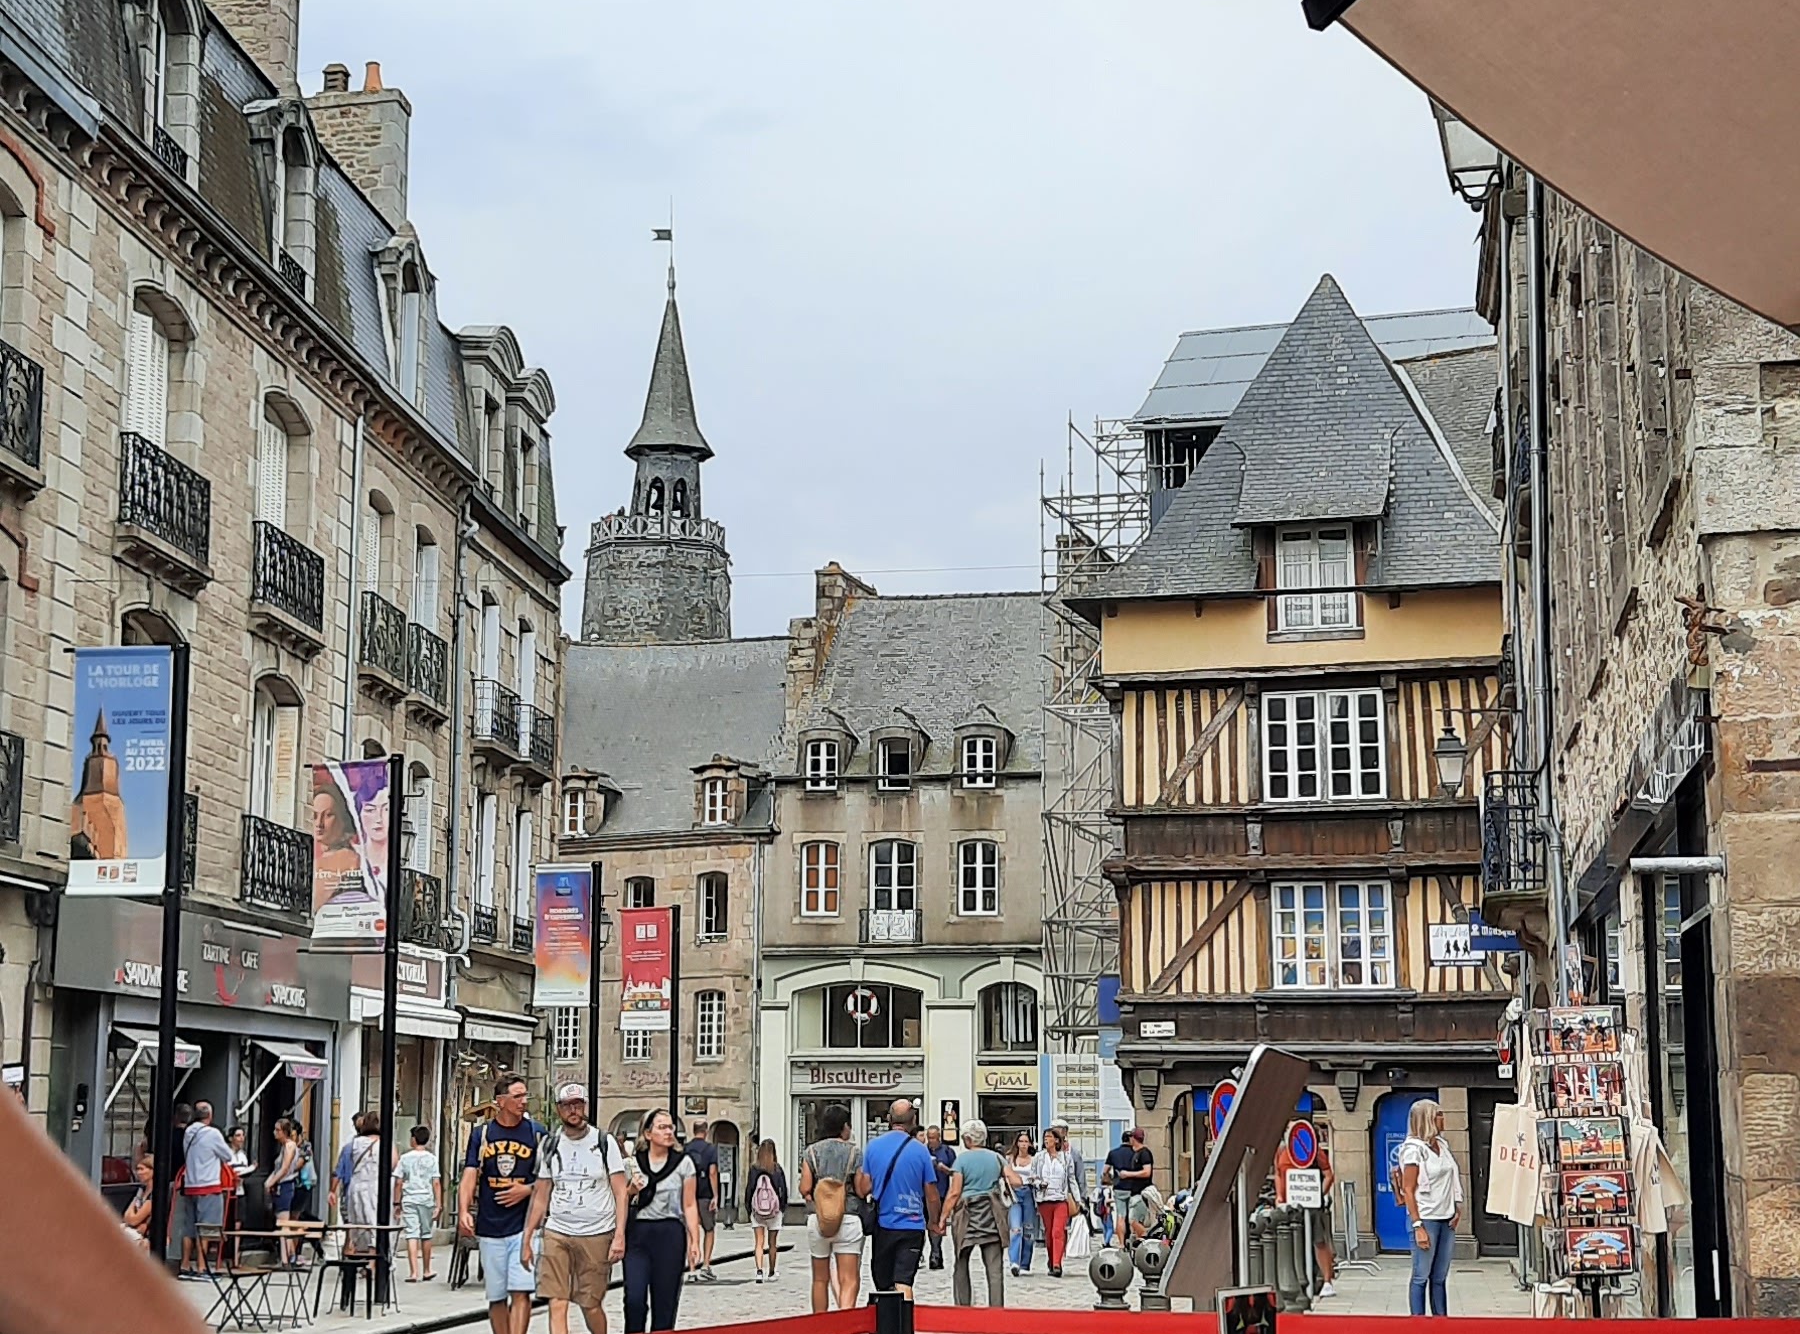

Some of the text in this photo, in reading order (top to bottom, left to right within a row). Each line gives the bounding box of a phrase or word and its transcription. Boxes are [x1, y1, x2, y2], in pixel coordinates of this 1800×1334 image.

[88, 663, 159, 676] LA TOUR DE
[88, 675, 159, 688] L'HORLOGE
[125, 756, 165, 771] 2022
[809, 1067, 902, 1085] Biscuiterie
[483, 1140, 532, 1159] NYPD
